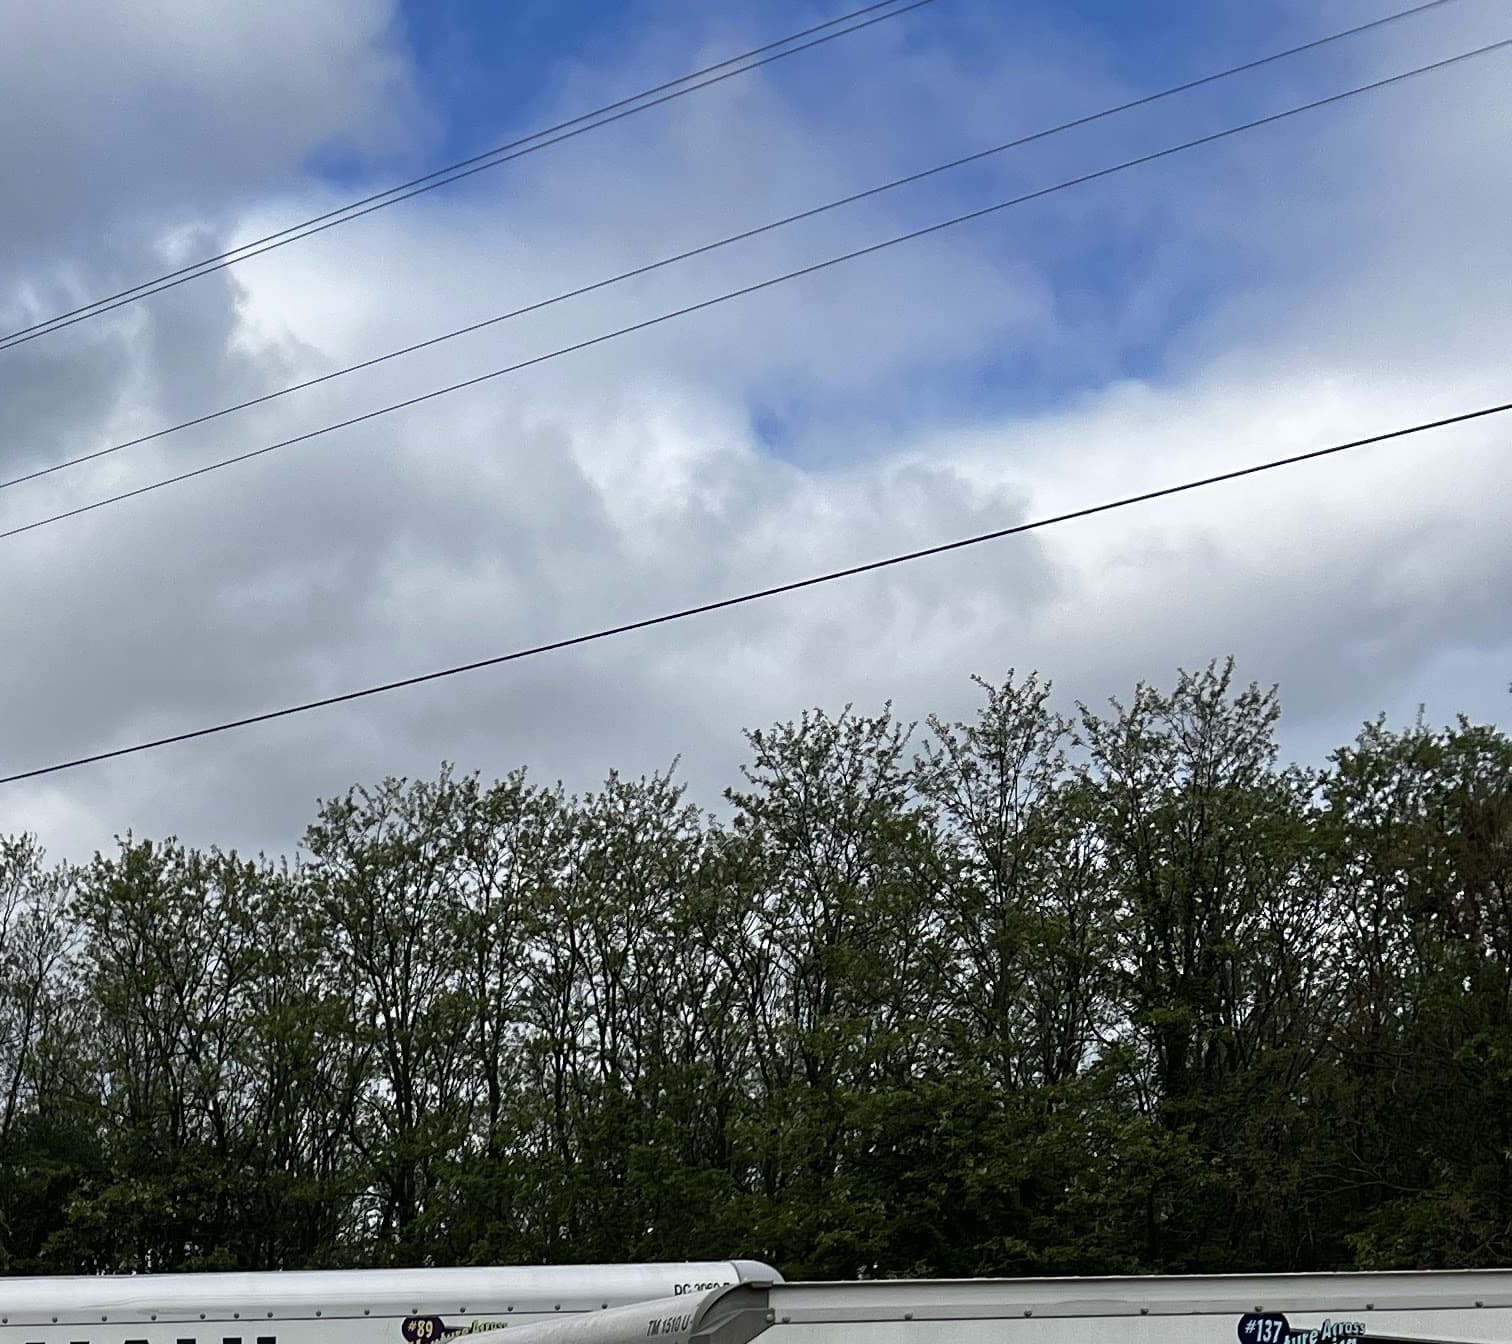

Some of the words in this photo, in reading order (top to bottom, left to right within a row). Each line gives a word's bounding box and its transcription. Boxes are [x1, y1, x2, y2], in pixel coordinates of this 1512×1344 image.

[408, 1320, 434, 1338] #89
[1244, 1319, 1283, 1344] #137
[1320, 1318, 1366, 1340] Across
